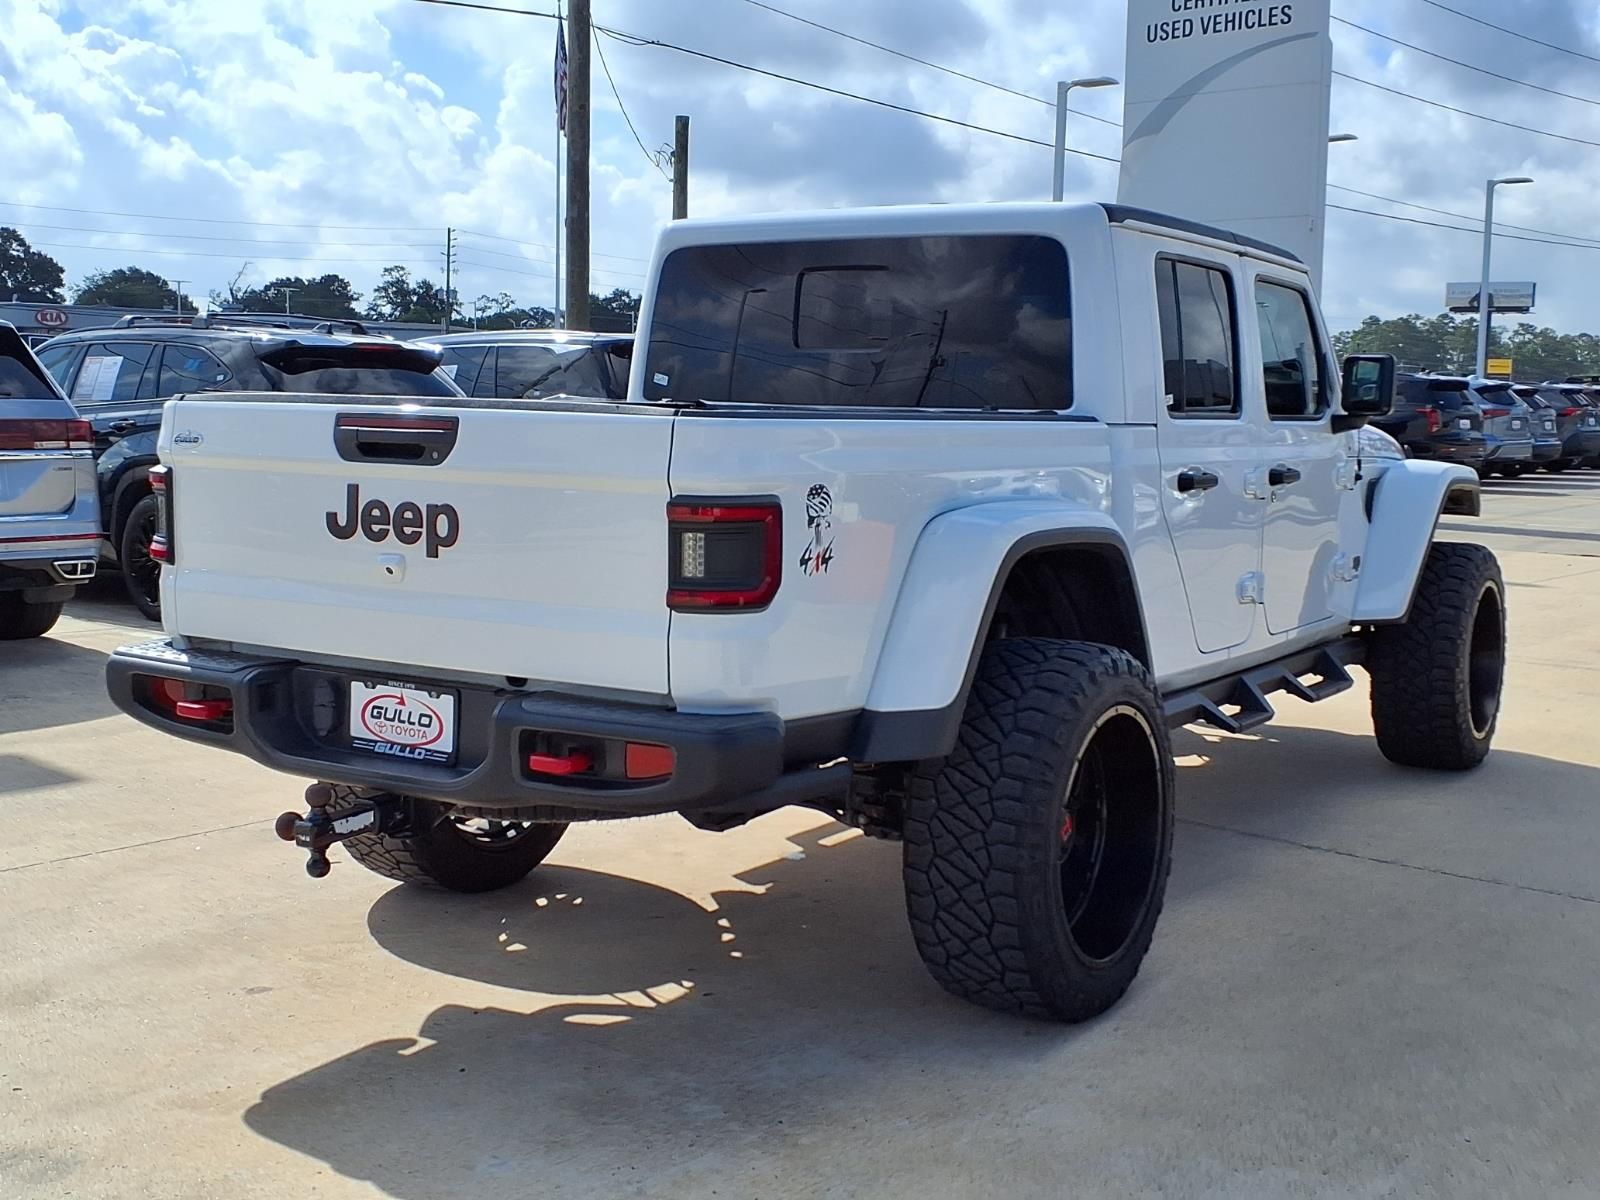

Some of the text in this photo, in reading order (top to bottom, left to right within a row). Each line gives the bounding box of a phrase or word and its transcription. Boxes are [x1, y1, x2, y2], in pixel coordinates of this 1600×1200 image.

[1146, 19, 1194, 43] USED
[1200, 5, 1293, 35] VEHICLES
[40, 312, 64, 322] KIA
[325, 483, 460, 559] Jeep
[370, 705, 433, 729] GULLO
[390, 724, 428, 740] TOYOTA
[374, 742, 426, 760] GULLO
